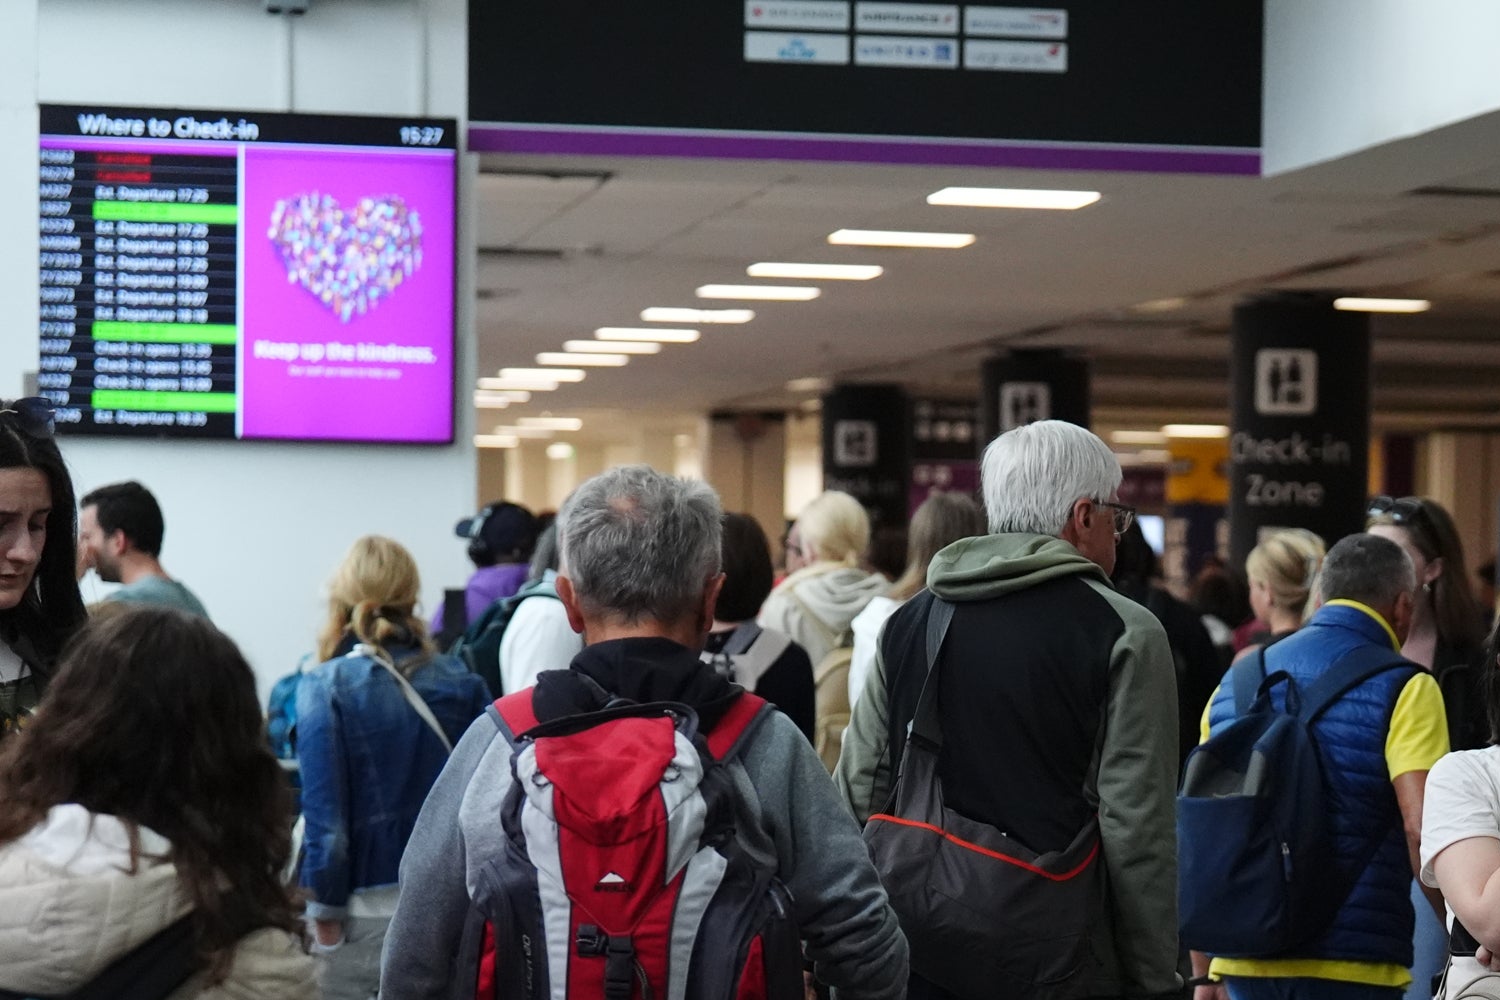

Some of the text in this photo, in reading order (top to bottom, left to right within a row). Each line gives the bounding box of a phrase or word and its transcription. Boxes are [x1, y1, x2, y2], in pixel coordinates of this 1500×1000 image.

[78, 114, 259, 139] Where to Check-in
[399, 126, 444, 147] 15:27
[253, 340, 299, 362] Keep
[300, 343, 325, 363] up
[325, 341, 356, 361] the
[1245, 473, 1325, 506] Zone
